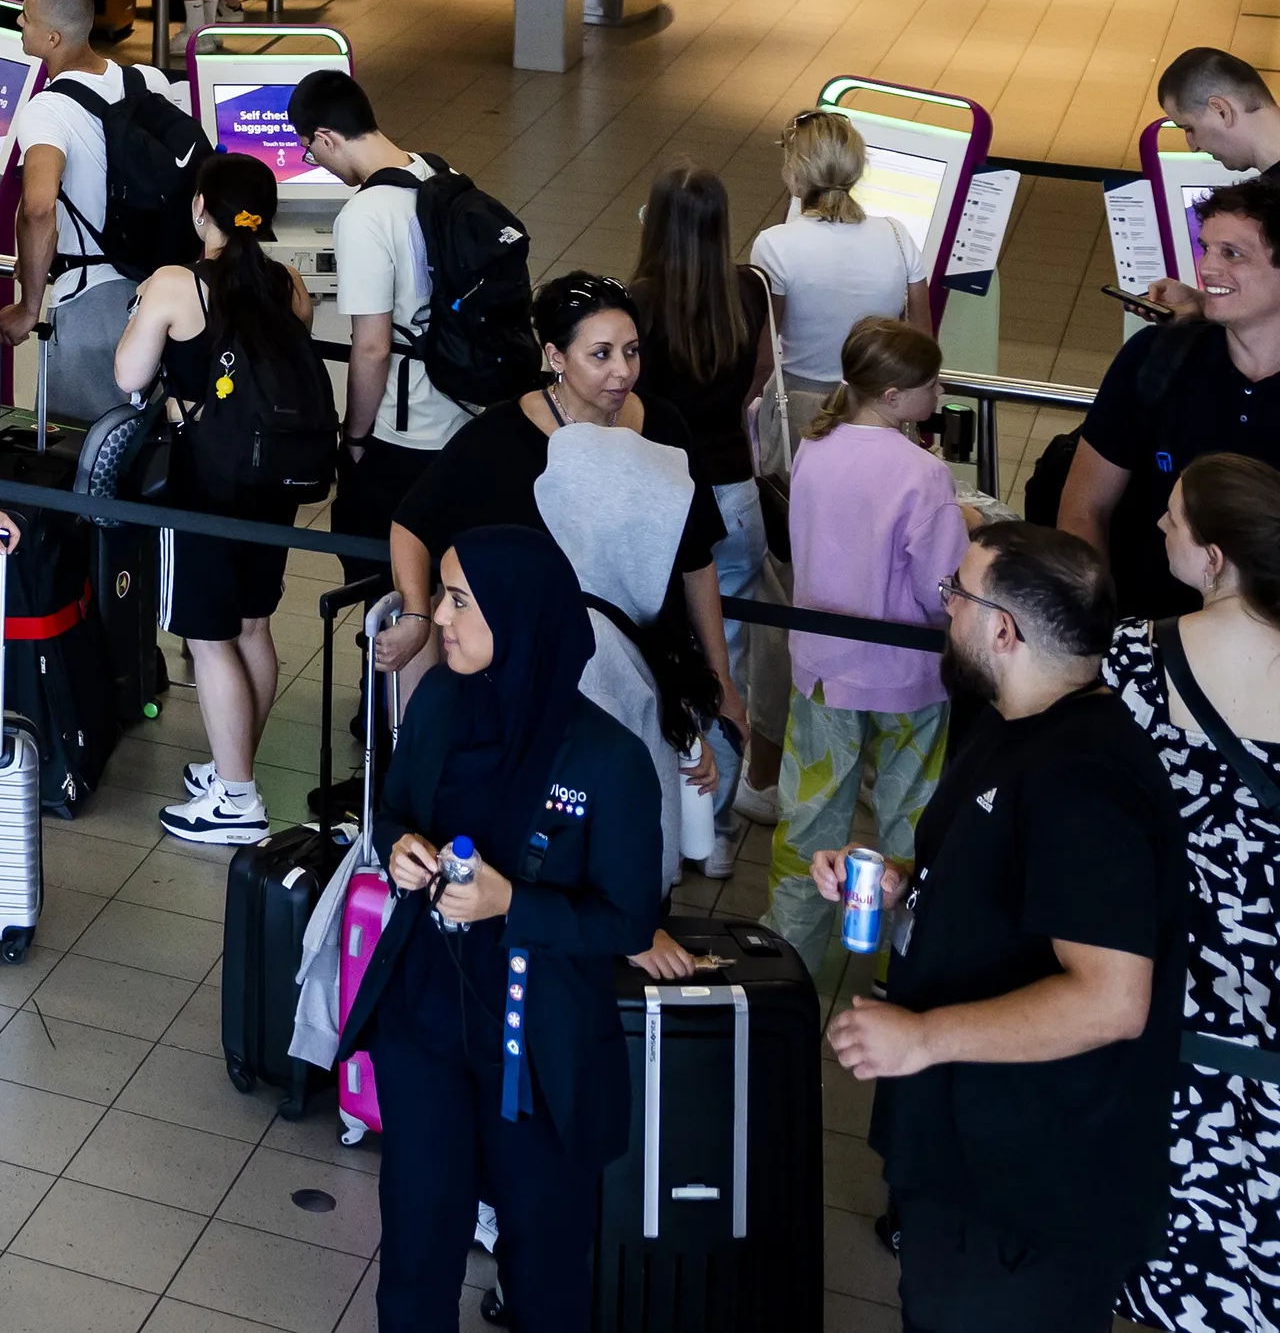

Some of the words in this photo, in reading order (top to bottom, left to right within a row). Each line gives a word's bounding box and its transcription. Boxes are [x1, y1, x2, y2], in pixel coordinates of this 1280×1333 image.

[0, 85, 8, 95] &
[240, 110, 261, 120] Self
[234, 122, 281, 134] baggage
